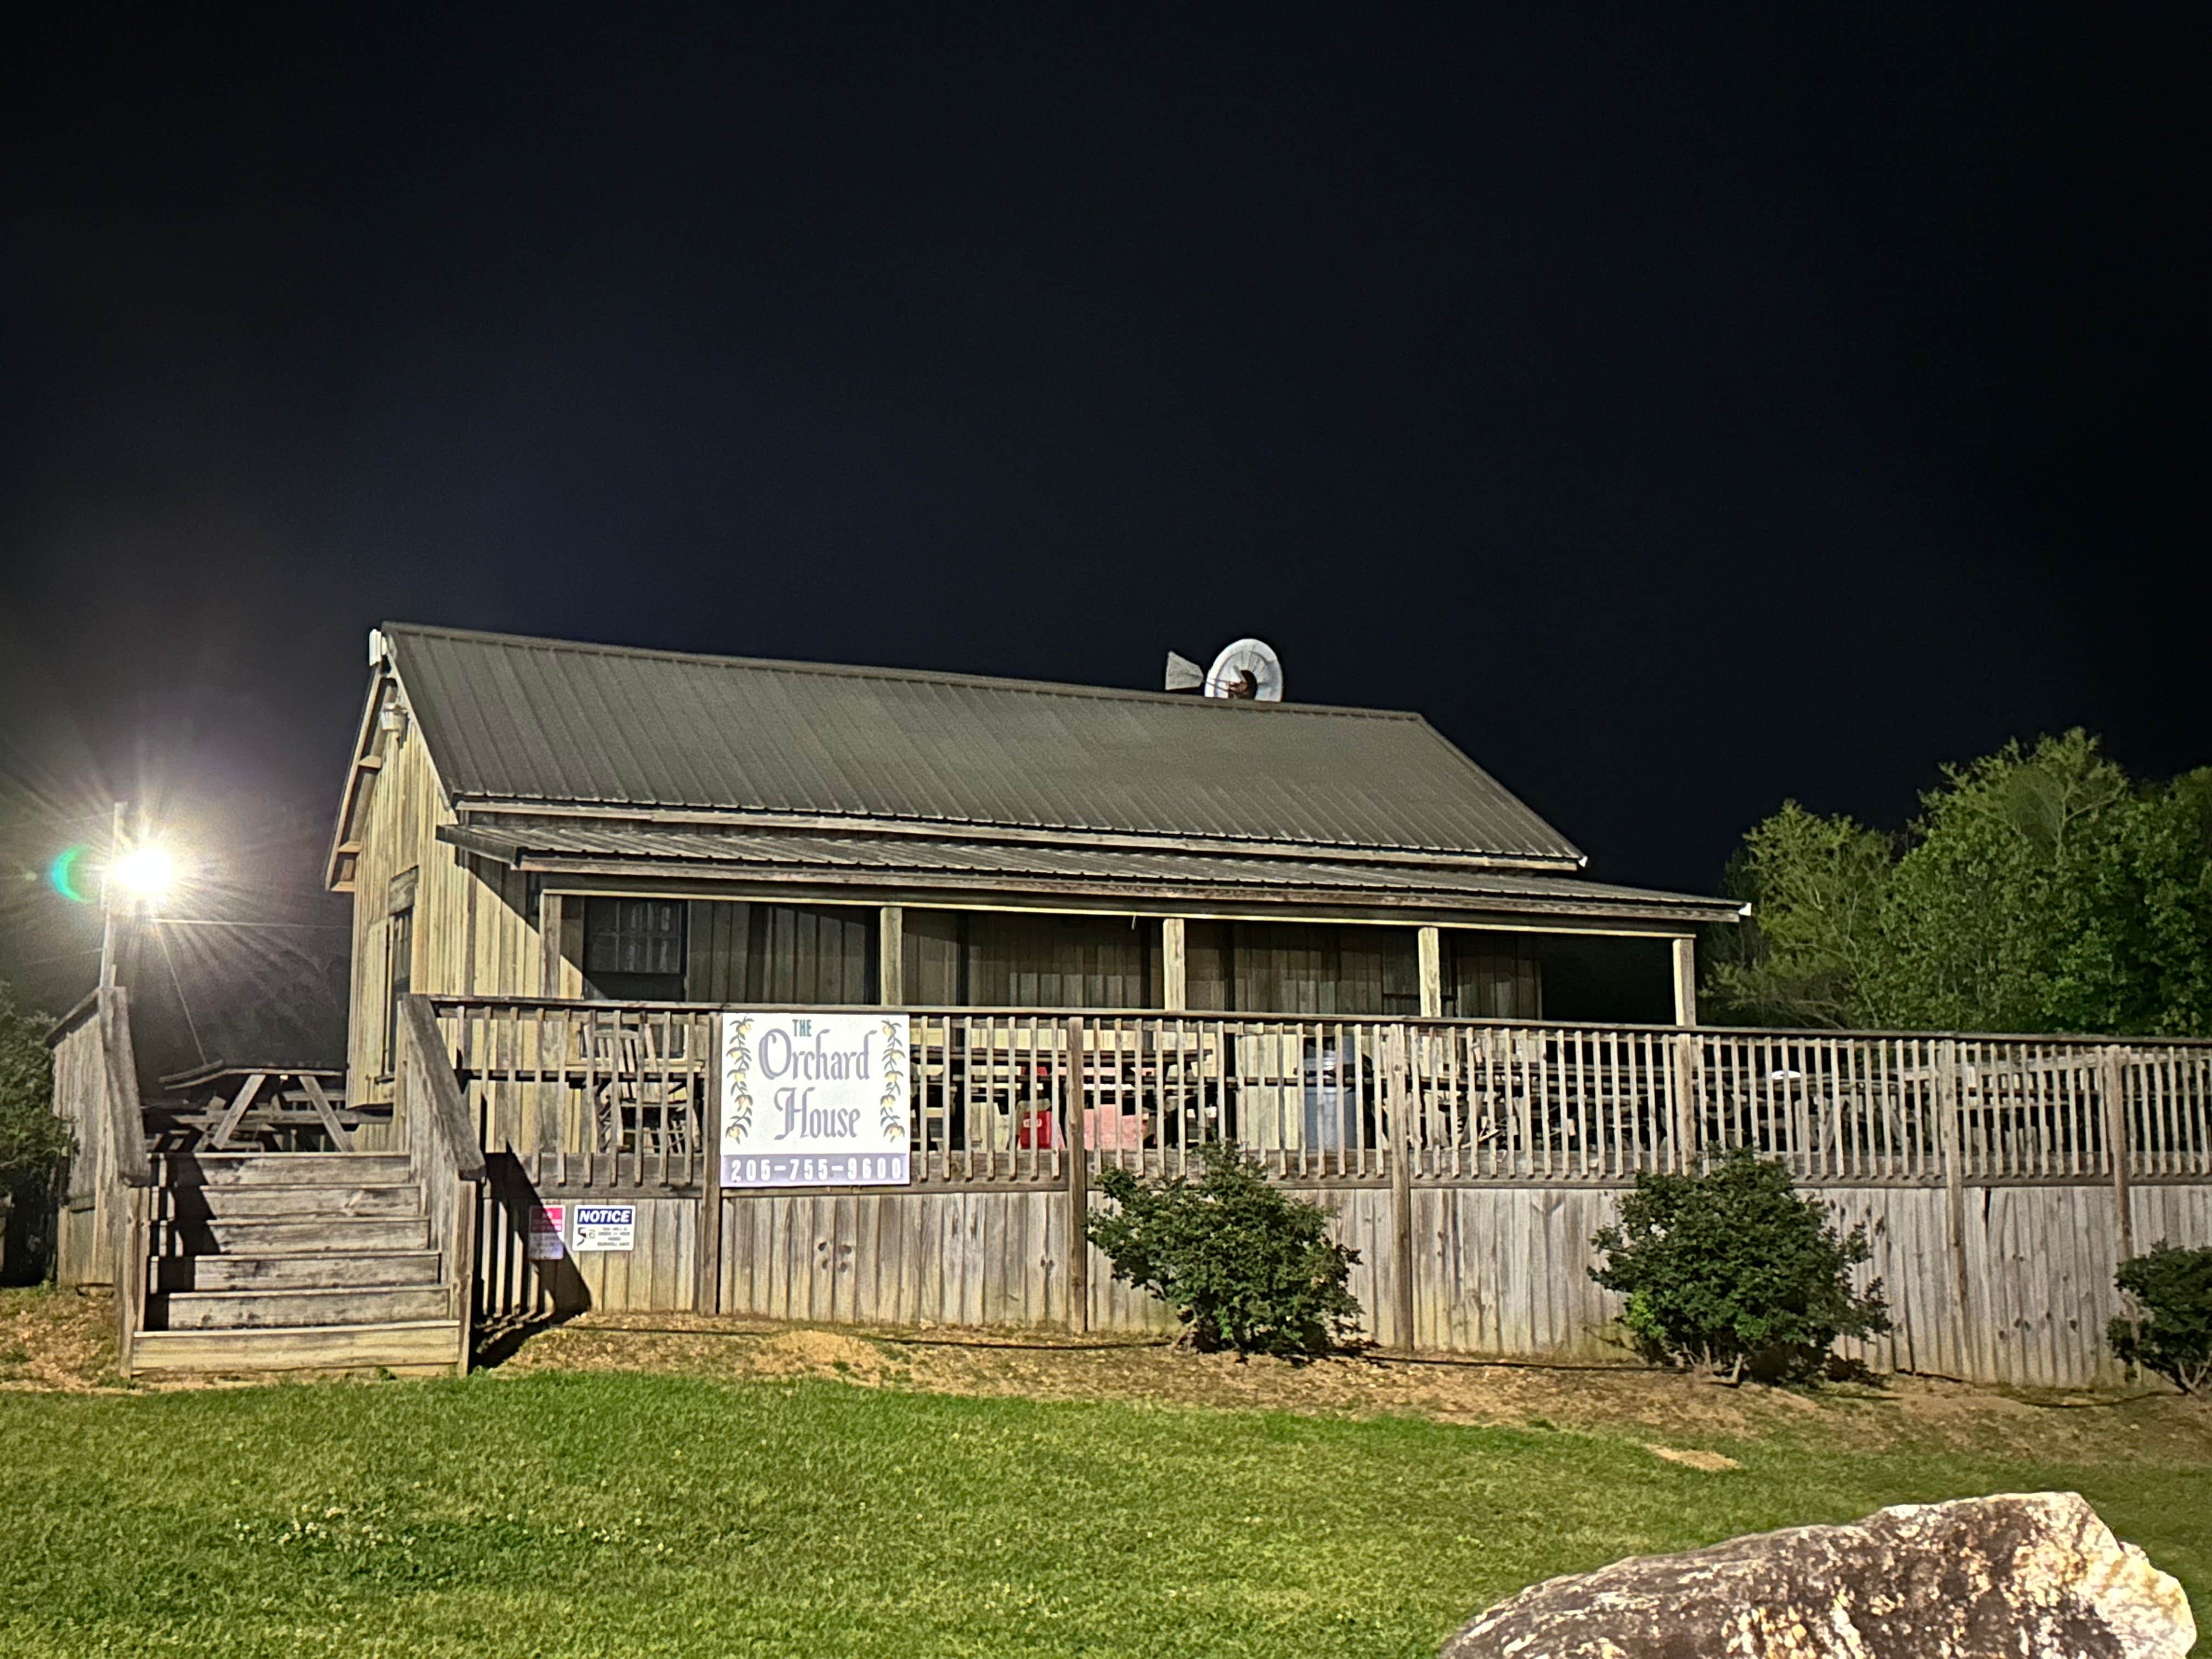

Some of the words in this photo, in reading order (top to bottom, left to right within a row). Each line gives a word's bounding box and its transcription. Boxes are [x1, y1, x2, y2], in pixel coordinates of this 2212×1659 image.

[792, 1019, 812, 1037] THE
[758, 1028, 877, 1080] Orchard
[774, 1087, 861, 1140] House
[731, 1158, 901, 1181] 205-755-9600
[579, 1210, 630, 1223] NOTICE
